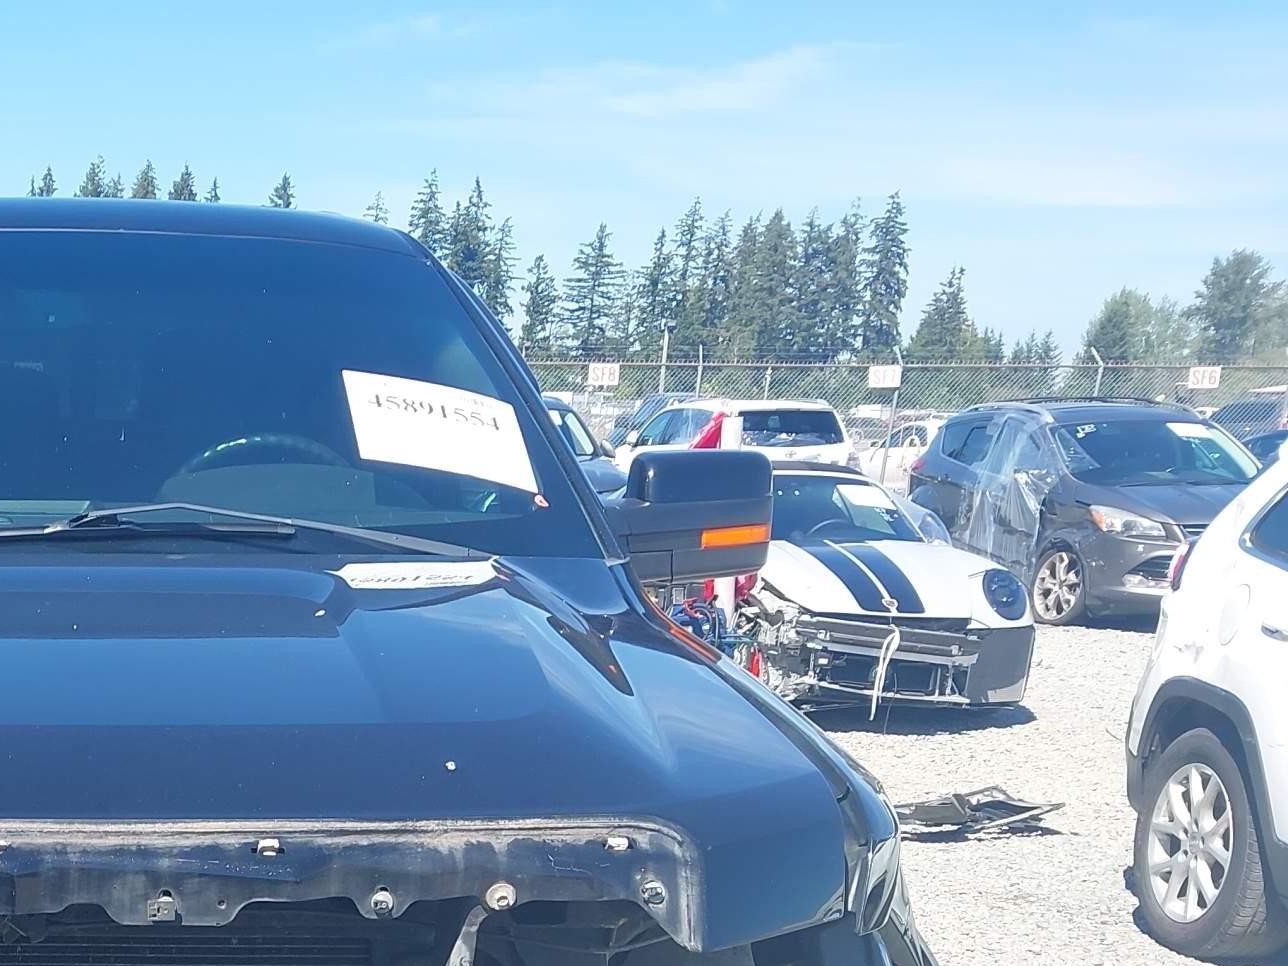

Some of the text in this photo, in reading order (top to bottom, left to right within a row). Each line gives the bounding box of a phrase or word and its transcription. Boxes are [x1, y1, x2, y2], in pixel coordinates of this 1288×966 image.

[592, 366, 617, 382] SF8
[1192, 369, 1217, 385] SF6
[368, 394, 500, 431] 45891554
